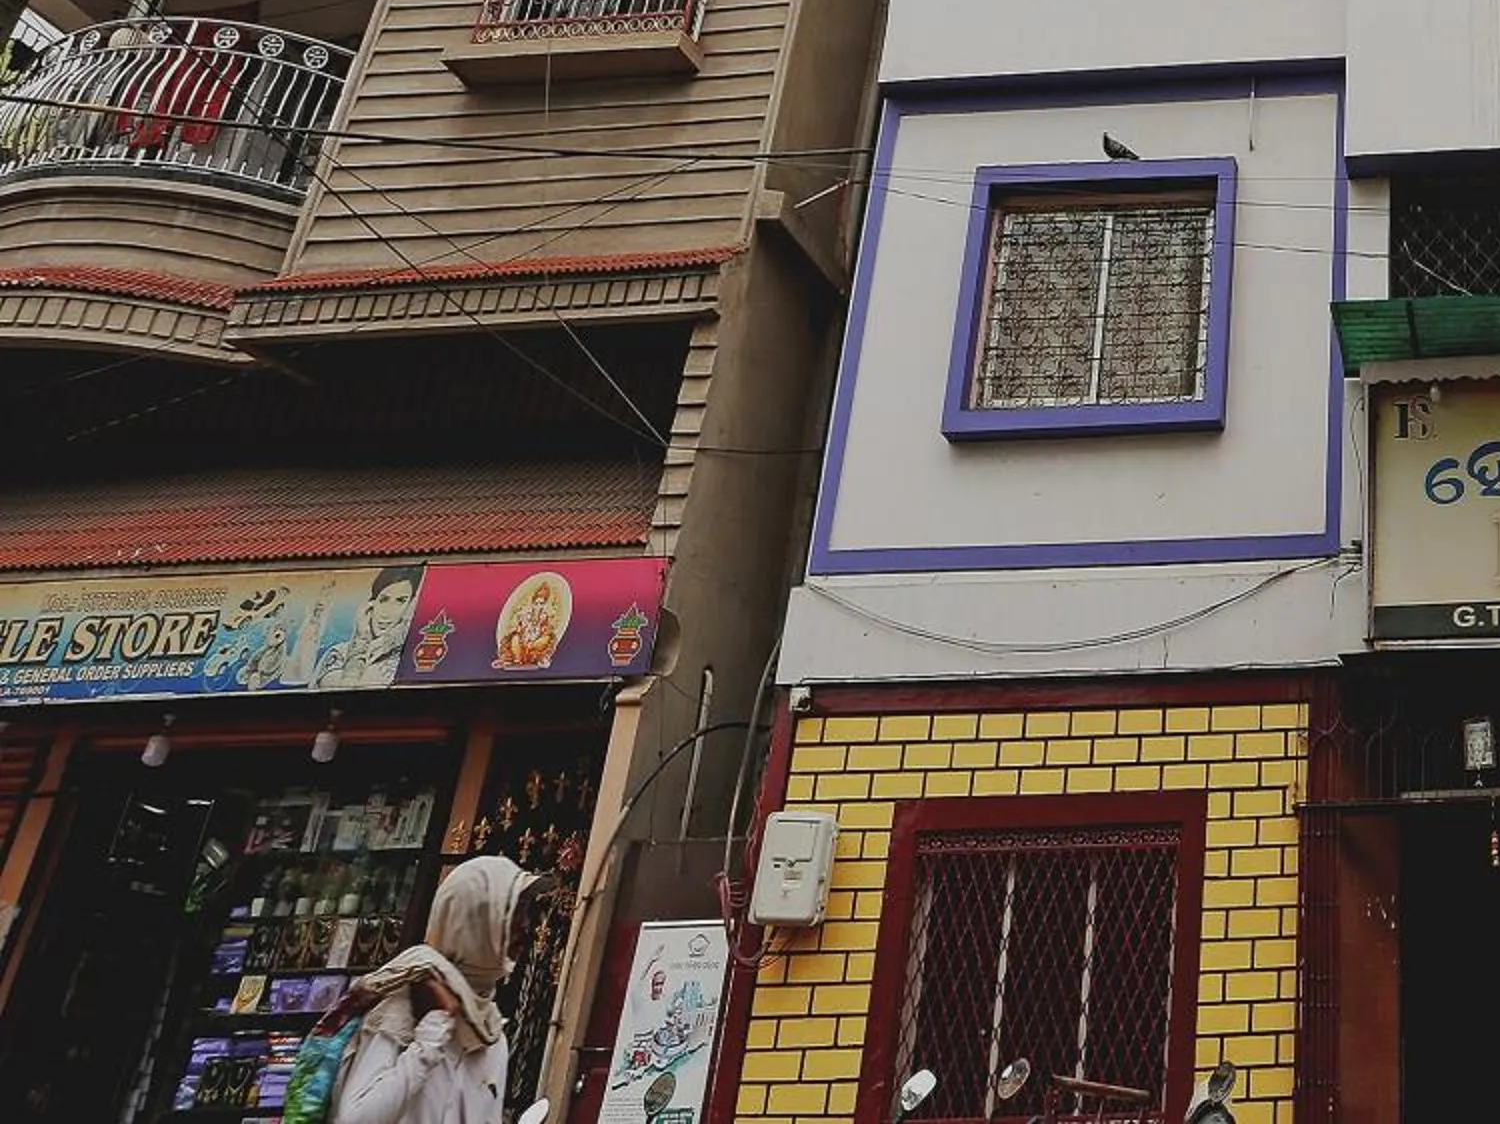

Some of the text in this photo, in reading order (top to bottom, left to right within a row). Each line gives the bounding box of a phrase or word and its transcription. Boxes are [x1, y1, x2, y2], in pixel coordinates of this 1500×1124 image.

[0, 610, 220, 665] LE STORE
[14, 667, 73, 684] GENERAL
[76, 665, 121, 682] ORDER
[123, 661, 195, 680] SUPPLIERS
